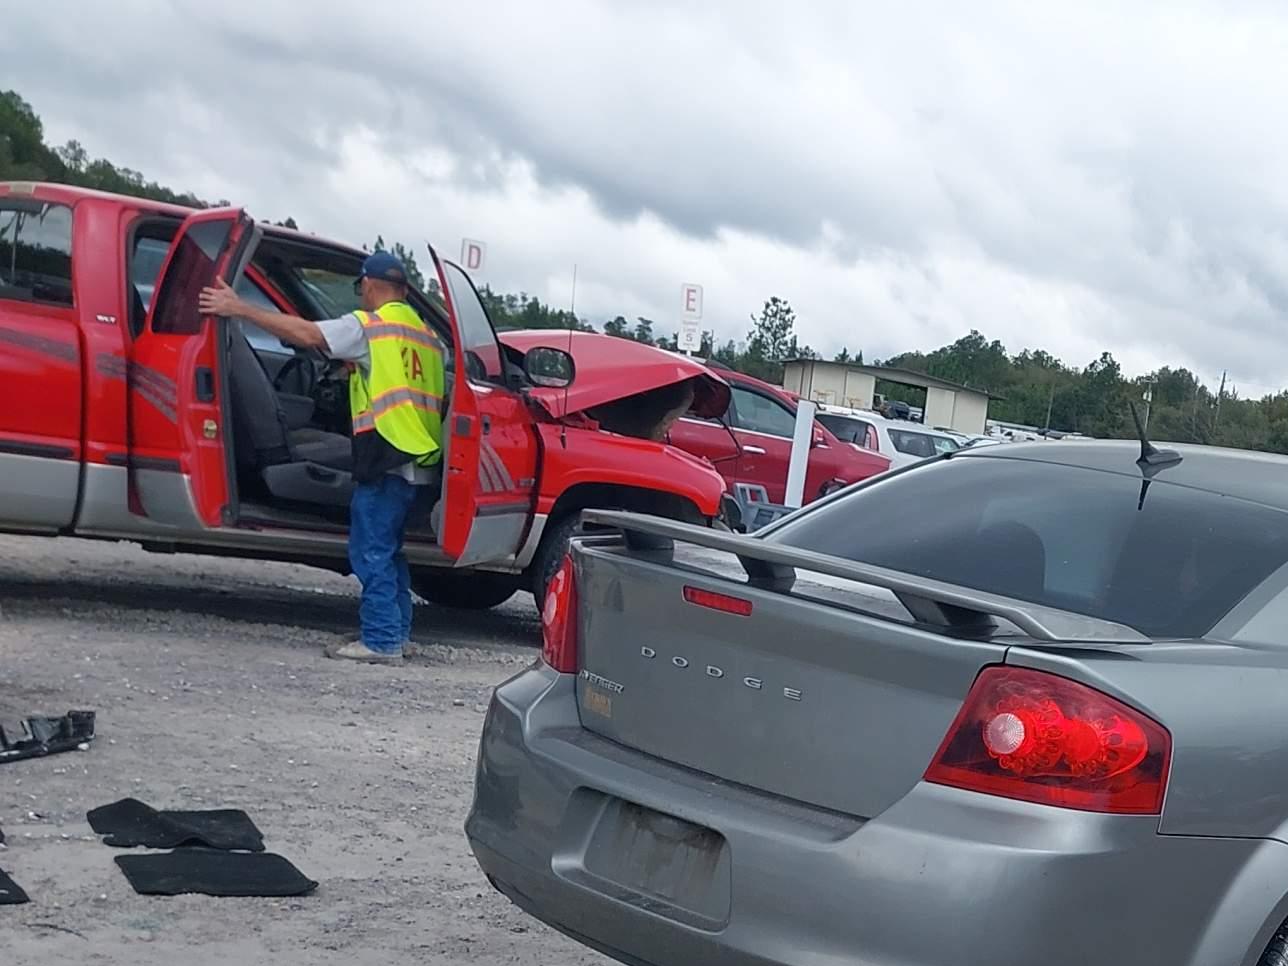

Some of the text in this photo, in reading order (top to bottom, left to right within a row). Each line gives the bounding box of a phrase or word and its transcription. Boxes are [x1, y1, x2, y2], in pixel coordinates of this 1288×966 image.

[468, 244, 481, 269] D
[686, 288, 697, 312] E
[640, 645, 803, 702] DODGE
